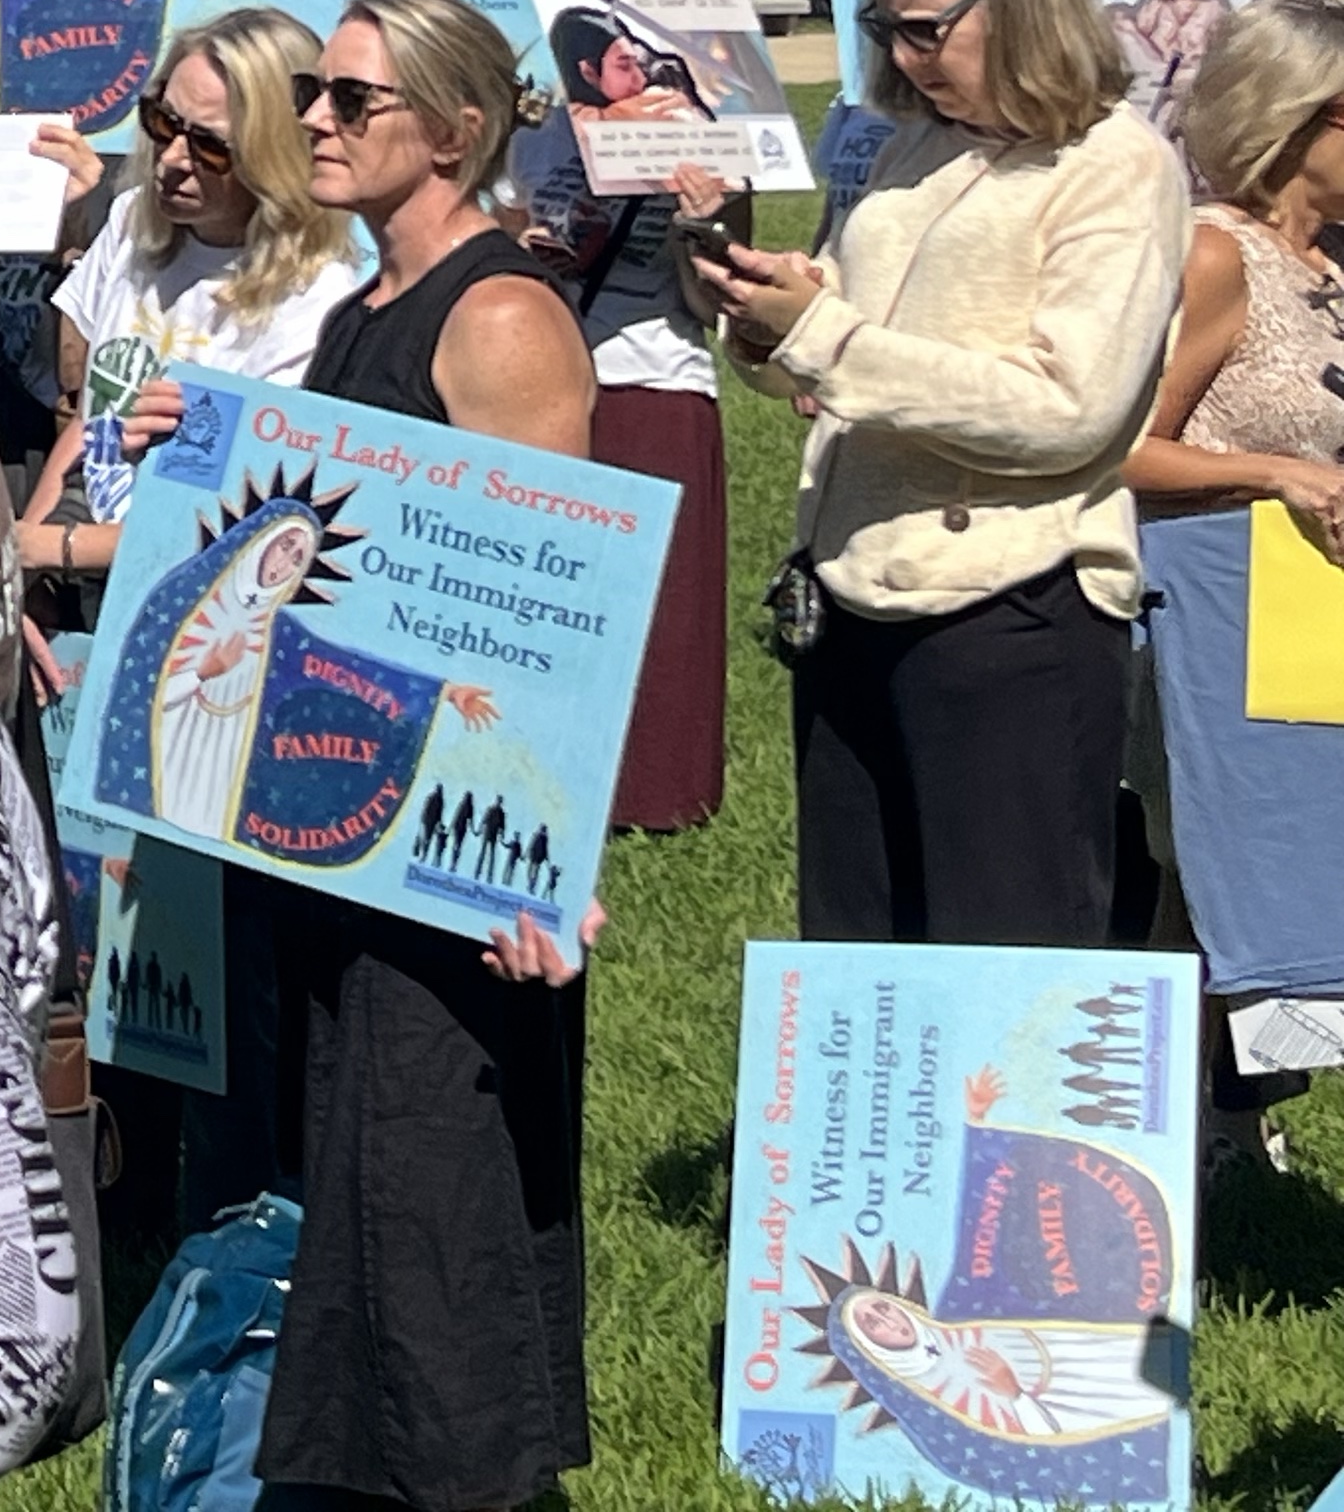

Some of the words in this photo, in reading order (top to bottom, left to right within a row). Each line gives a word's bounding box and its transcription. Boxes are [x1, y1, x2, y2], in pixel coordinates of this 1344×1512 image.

[20, 24, 123, 60] FAMILY
[253, 407, 323, 452] Our
[329, 424, 421, 486] Lady
[427, 460, 470, 489] of
[482, 469, 638, 534] Sorrows
[400, 502, 526, 567] Witness
[534, 540, 586, 581] for
[362, 545, 424, 586] Our
[427, 562, 607, 637] Immigrant
[387, 601, 553, 675] Neighbors
[302, 654, 407, 721] DIGNITY
[272, 733, 381, 765] FAMILY
[245, 777, 401, 851] SOLIDARITY
[764, 969, 802, 1124] Sorrows
[819, 1010, 853, 1060] for
[859, 981, 899, 1161] Immigrant
[811, 1068, 849, 1207] Witness
[903, 1024, 942, 1197] Neighbors
[762, 1143, 789, 1185] of
[855, 1170, 886, 1238] Our
[749, 1196, 796, 1295] Lady
[970, 1160, 1015, 1278] DIGNITY
[1038, 1180, 1080, 1296] FAMILY
[1070, 1150, 1162, 1312] SOLIDARITY
[744, 1308, 783, 1392] Our
